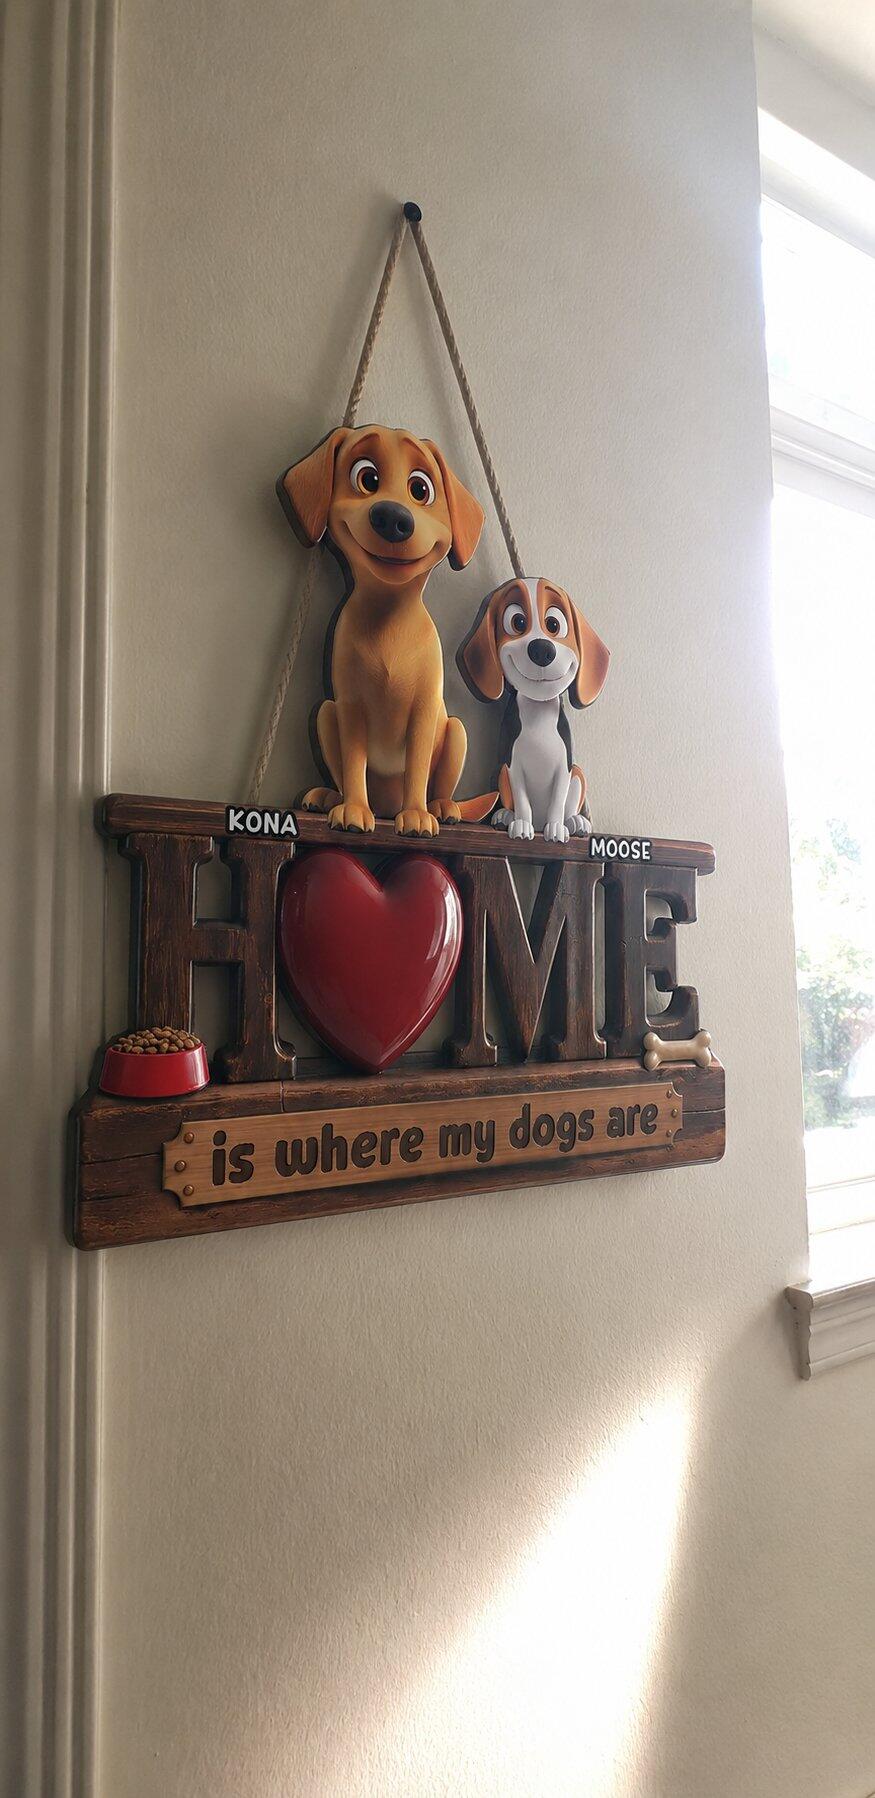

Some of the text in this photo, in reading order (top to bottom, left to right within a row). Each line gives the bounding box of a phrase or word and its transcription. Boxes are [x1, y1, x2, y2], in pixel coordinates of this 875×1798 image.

[228, 808, 298, 836] KONA
[591, 838, 651, 860] MOOSE
[211, 1103, 659, 1186] is where my dogs are
